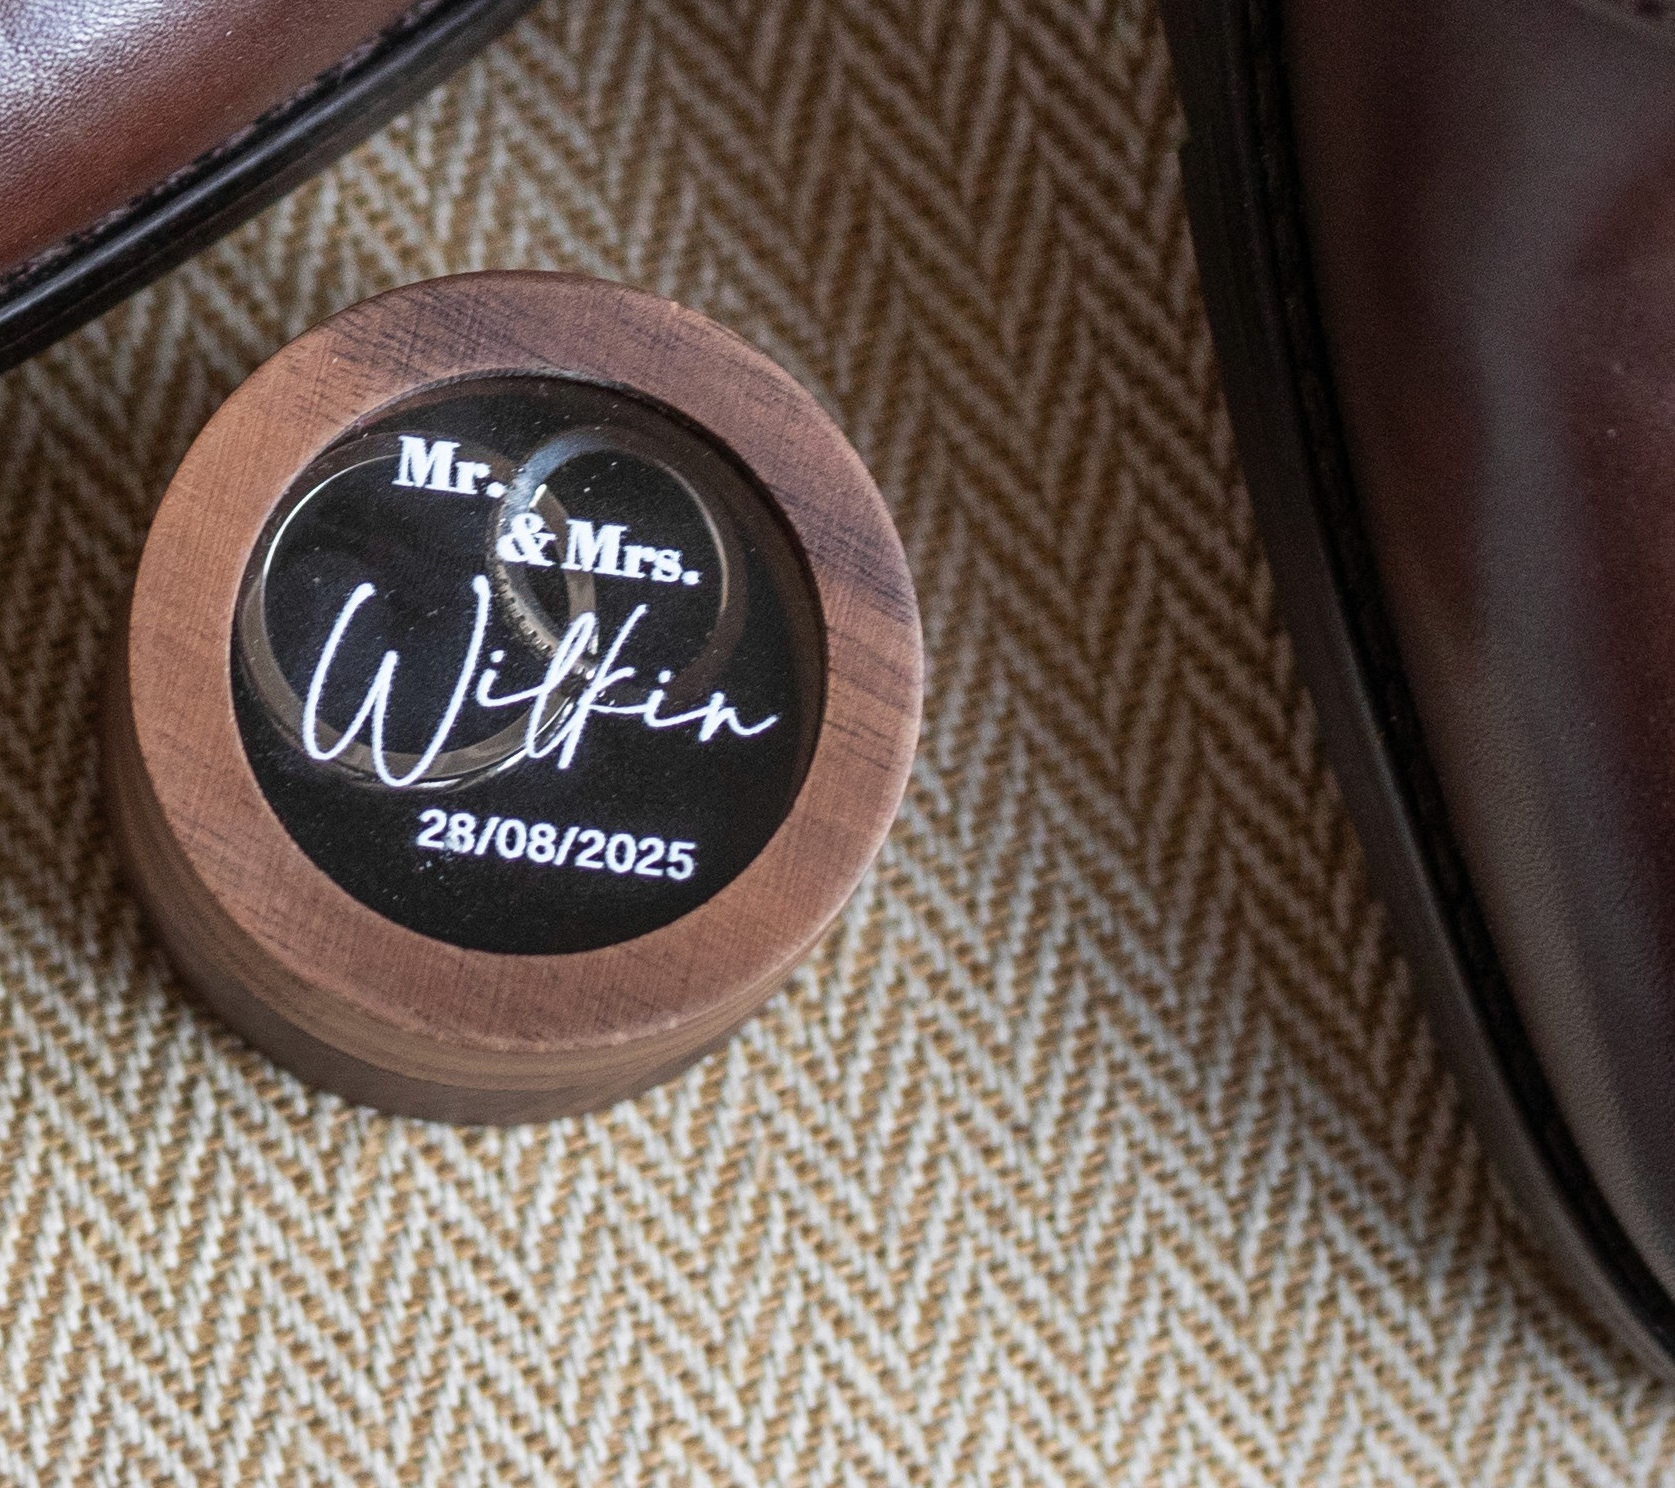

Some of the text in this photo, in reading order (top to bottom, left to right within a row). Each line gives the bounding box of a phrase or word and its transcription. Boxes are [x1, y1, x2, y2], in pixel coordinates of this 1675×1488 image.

[392, 434, 505, 499] Mr.
[495, 510, 702, 586] & Mrs.
[302, 574, 780, 788] Wilkin
[415, 808, 696, 881] 28/08/2025
